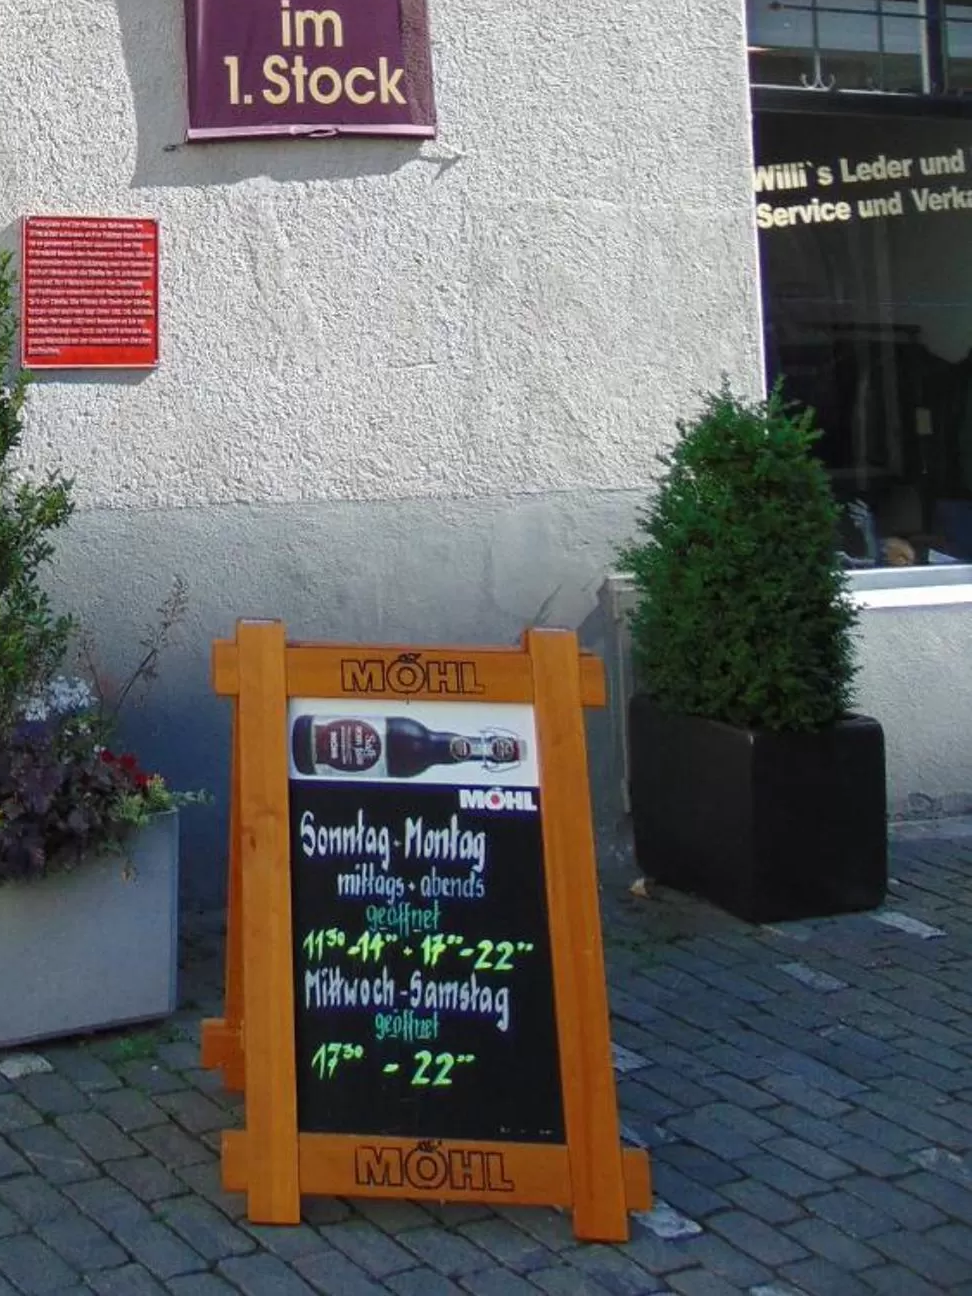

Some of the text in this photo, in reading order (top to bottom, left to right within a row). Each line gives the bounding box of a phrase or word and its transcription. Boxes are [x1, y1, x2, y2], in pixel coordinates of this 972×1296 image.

[280, 0, 343, 48] im
[224, 54, 407, 105] 1. Stock
[838, 154, 913, 183] Leder
[919, 147, 966, 176] und
[756, 197, 852, 229] Service
[857, 190, 904, 219] und
[300, 808, 390, 871] Sonntag
[404, 812, 486, 873] Montag
[337, 861, 405, 904] mittags
[420, 865, 485, 898] abends
[304, 965, 395, 1010] Mittwoch
[409, 969, 510, 1032] Samstag
